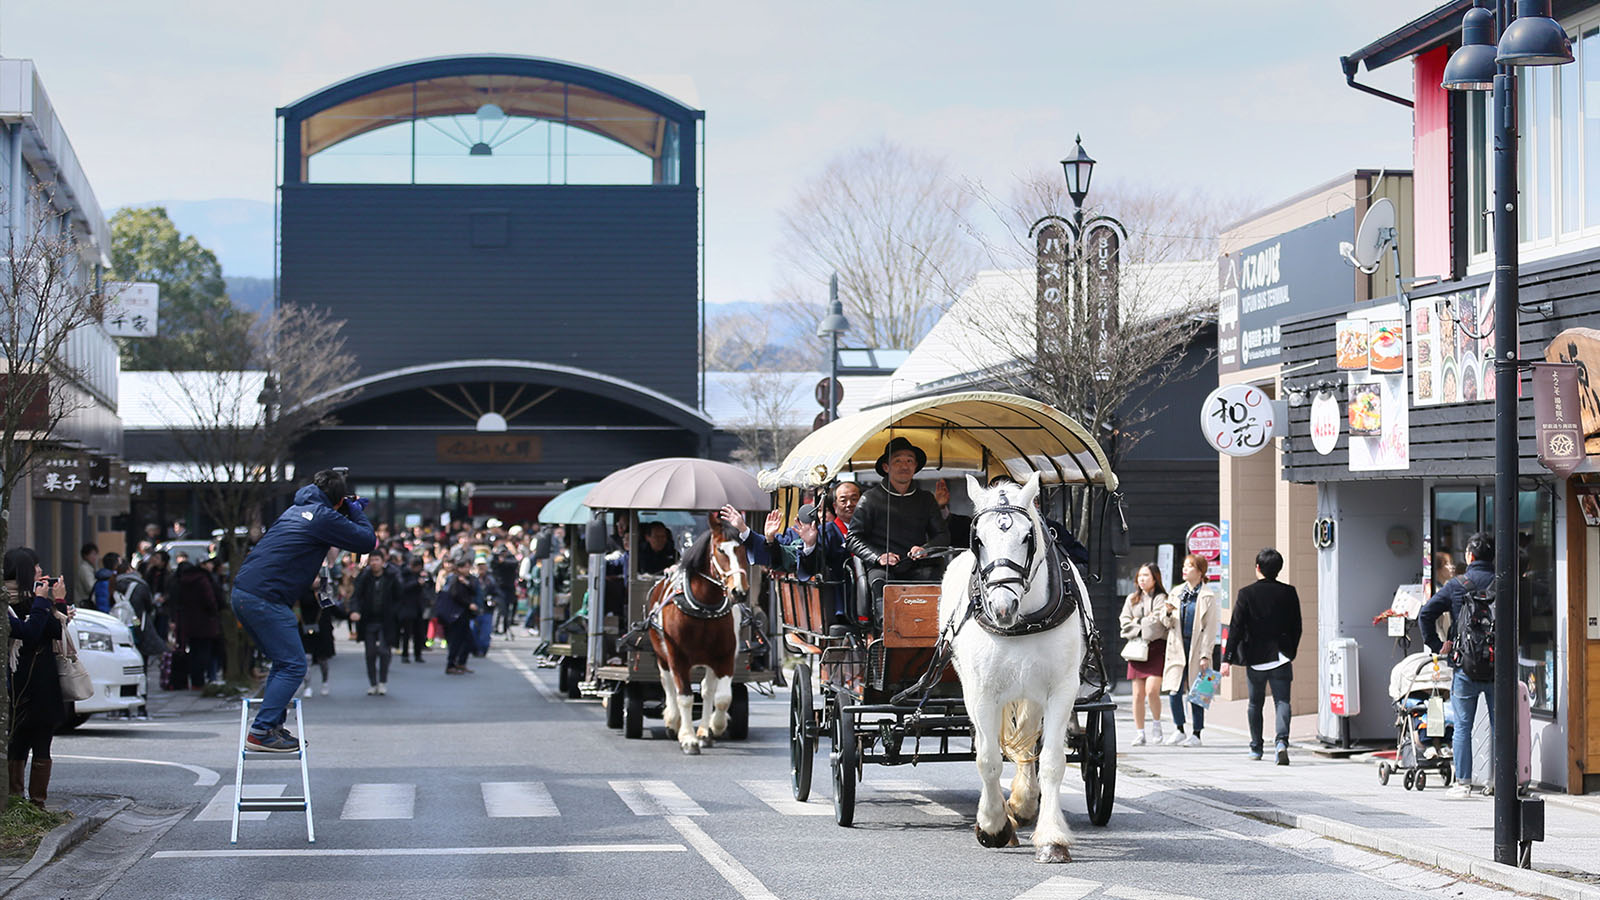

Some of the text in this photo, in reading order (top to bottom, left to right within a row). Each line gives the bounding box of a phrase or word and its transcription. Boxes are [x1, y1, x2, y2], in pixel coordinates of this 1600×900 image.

[1241, 242, 1281, 290] バスのりば
[43, 473, 81, 492] 菓子
